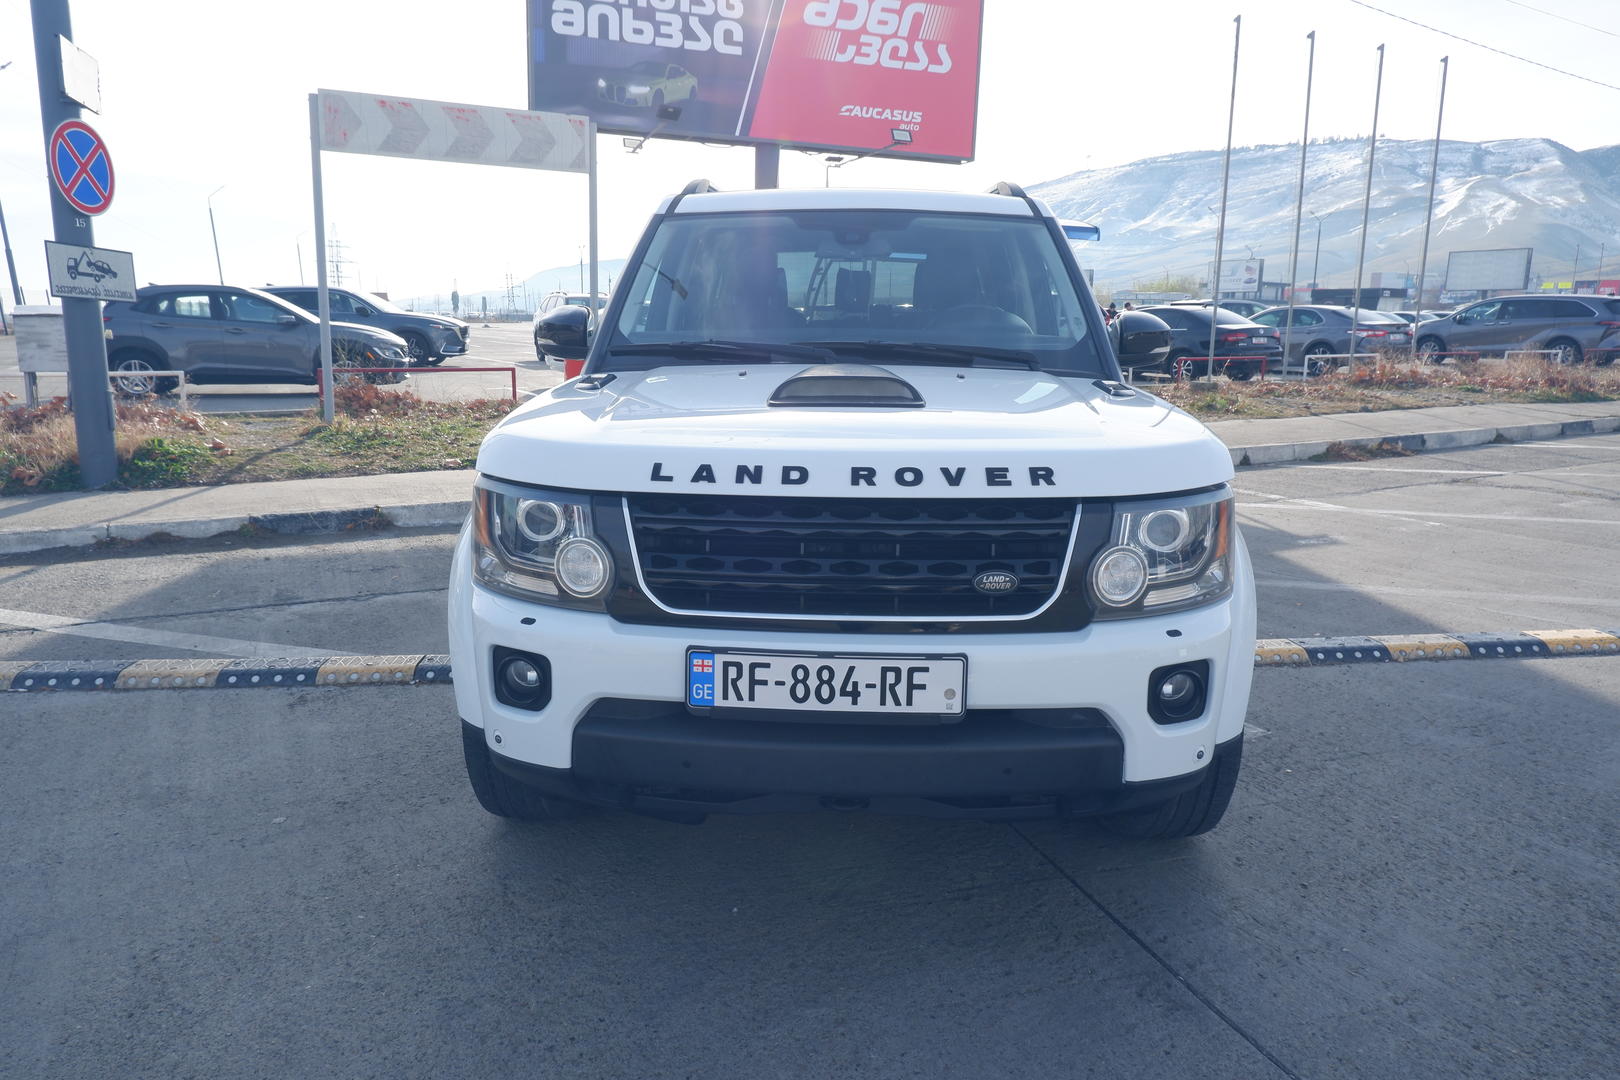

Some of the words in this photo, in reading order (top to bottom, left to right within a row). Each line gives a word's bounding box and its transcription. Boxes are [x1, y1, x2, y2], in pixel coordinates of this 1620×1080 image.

[839, 104, 923, 123] CAUCASUS
[899, 122, 920, 131] auto
[75, 217, 86, 228] 15
[650, 462, 810, 486] LAND
[850, 466, 1057, 487] ROVER
[982, 575, 1005, 583] LAND
[984, 582, 1012, 590] ROVER
[721, 660, 931, 707] RF-884-RF
[692, 683, 713, 700] GE
